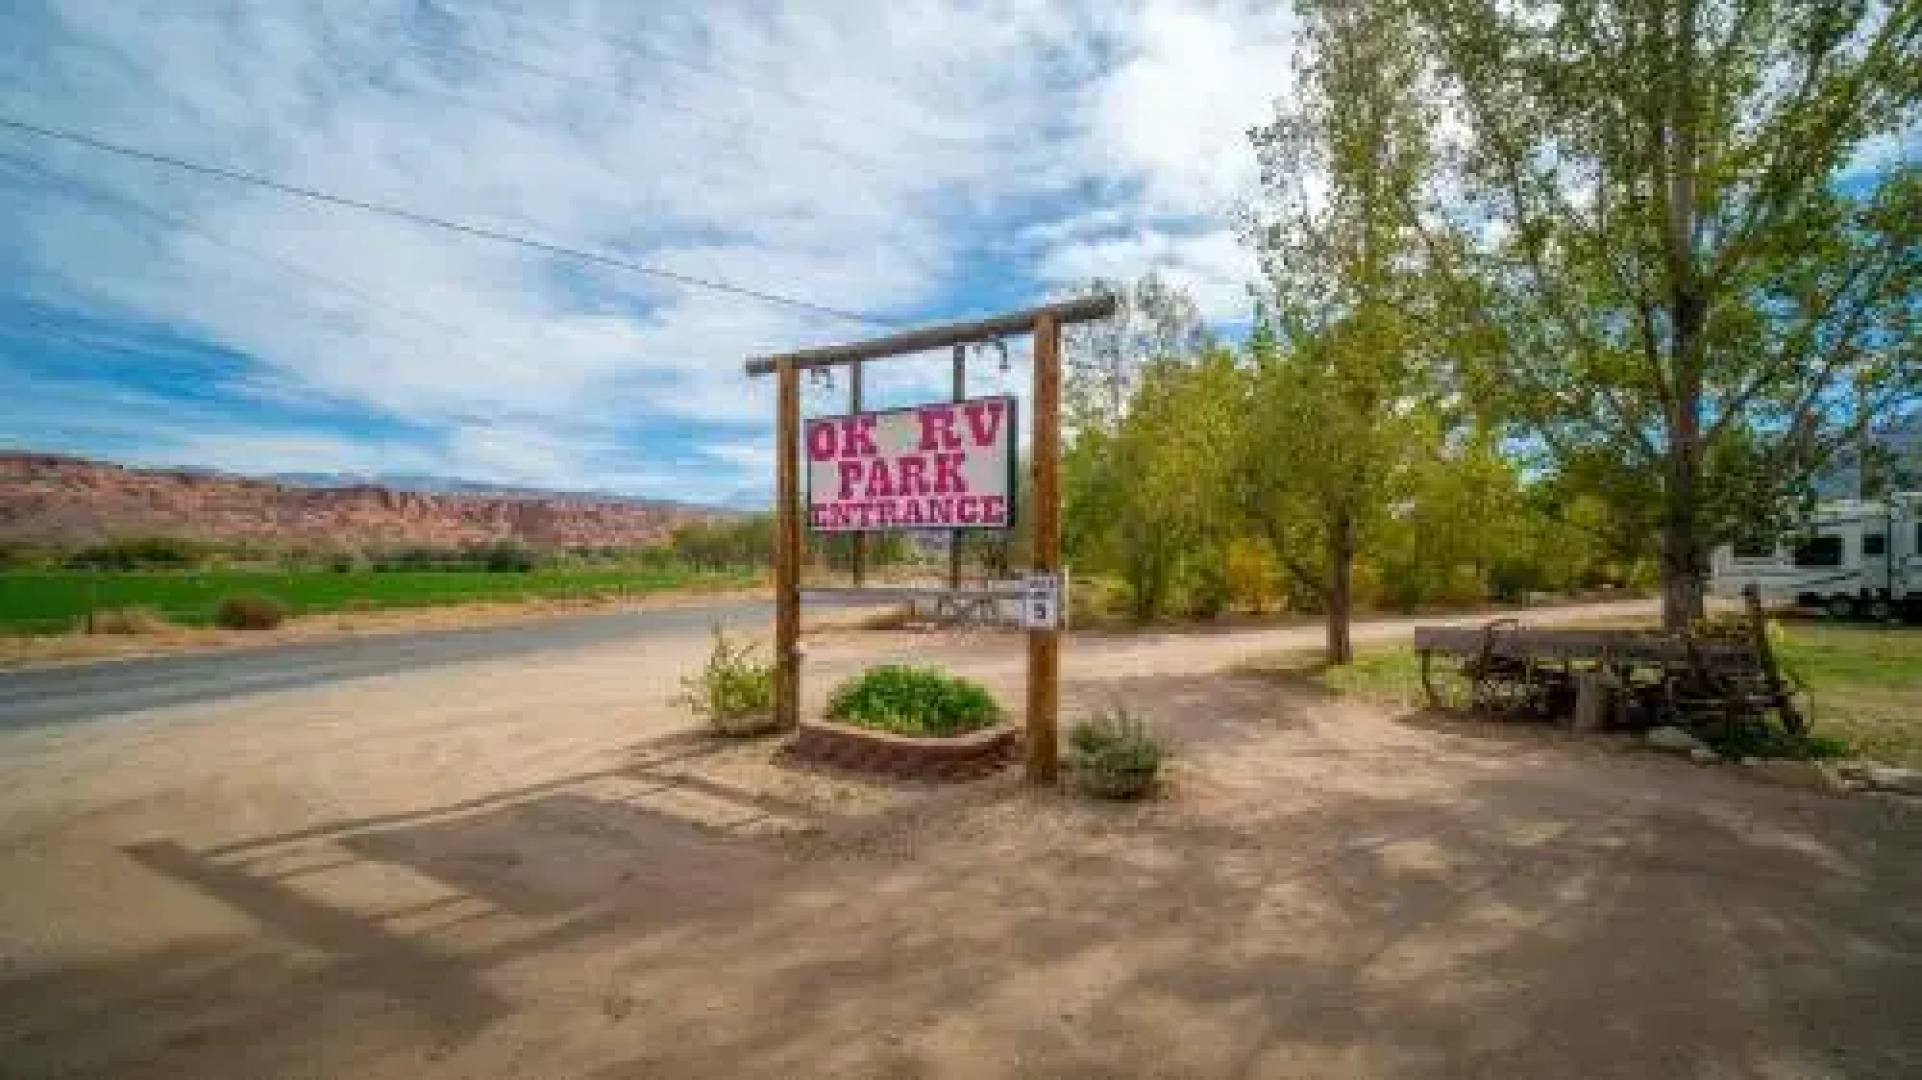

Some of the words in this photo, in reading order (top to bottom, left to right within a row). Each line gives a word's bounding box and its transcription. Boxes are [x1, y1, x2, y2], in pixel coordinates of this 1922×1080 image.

[807, 415, 877, 461] OK
[920, 403, 1004, 450] RV
[837, 452, 968, 499] PARK
[808, 495, 1004, 528] ENTRANCE
